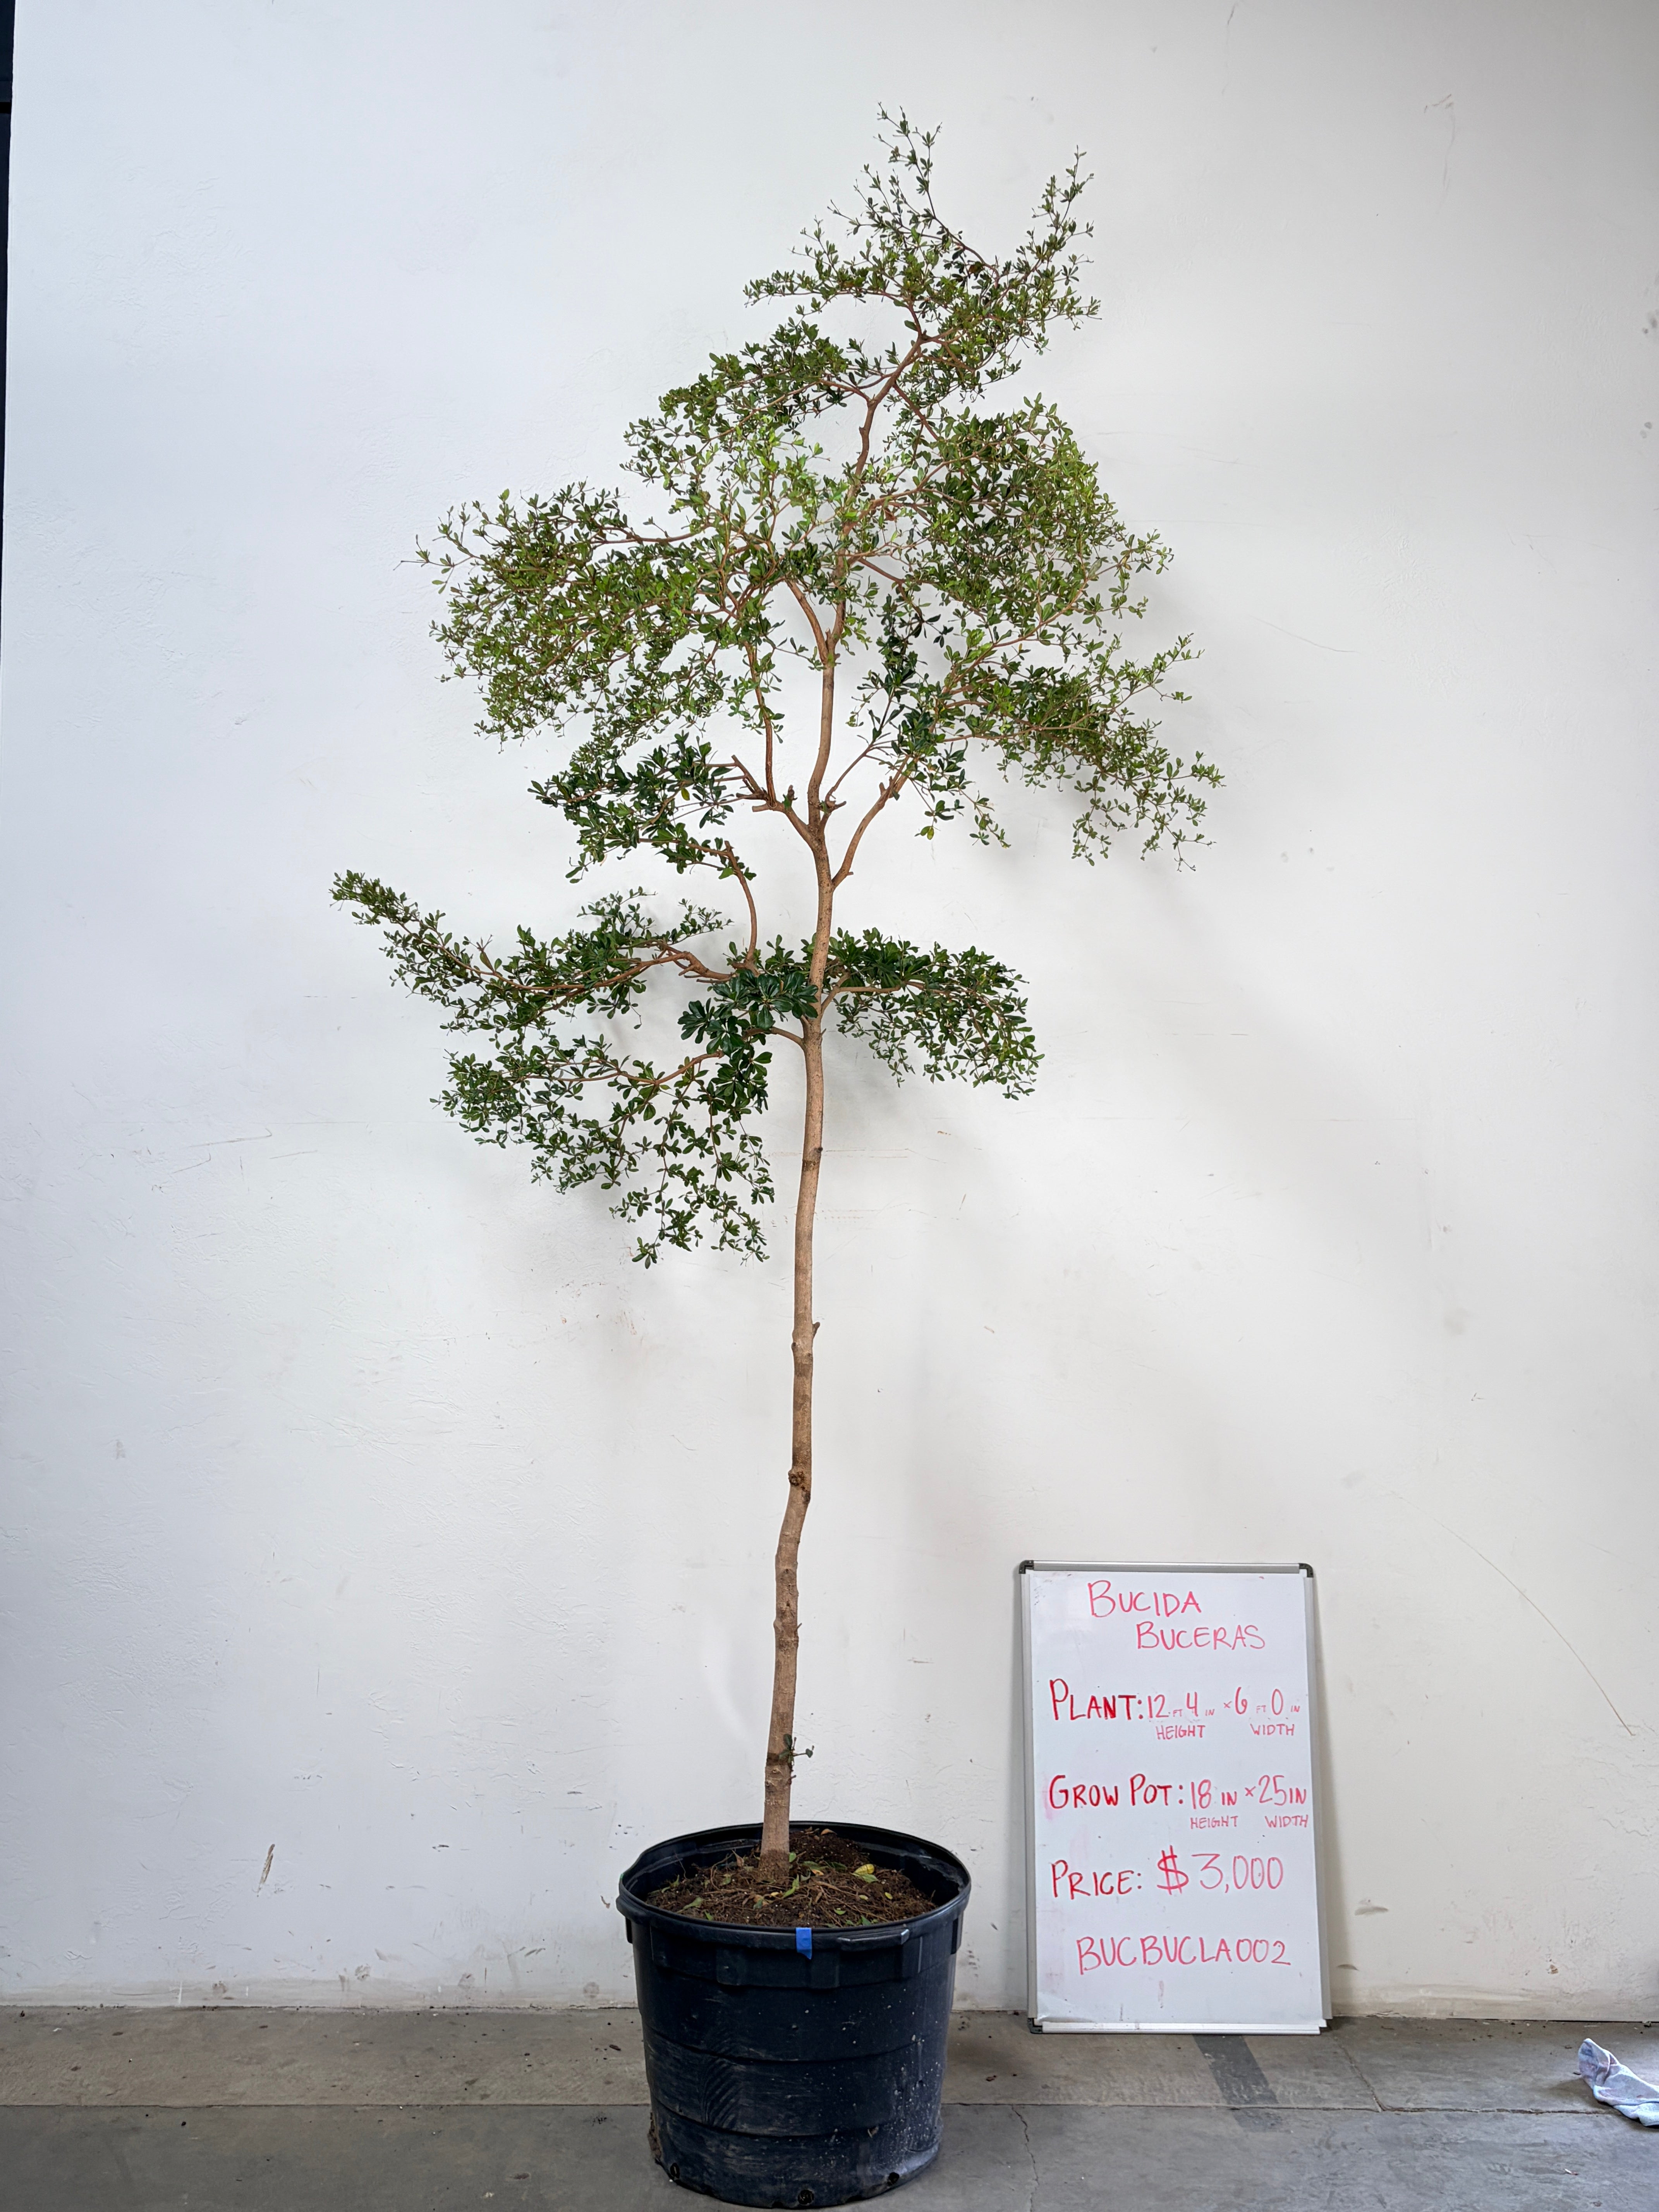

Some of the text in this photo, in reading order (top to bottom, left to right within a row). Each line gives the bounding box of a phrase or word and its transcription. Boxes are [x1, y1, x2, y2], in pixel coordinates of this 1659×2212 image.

[1087, 1580, 1202, 1618] BUCIDA
[1135, 1621, 1266, 1651] BUCERAS
[1048, 1678, 1144, 1721] PLANT:
[1156, 1723, 1295, 1740] HEIGHT WIDTH
[1048, 1774, 1119, 1810] GROW
[1129, 1773, 1184, 1807] POT:
[1190, 1779, 1212, 1810] 18
[1190, 1815, 1309, 1829] HEIGHT WIDTH
[1051, 1859, 1142, 1900] PRICE:
